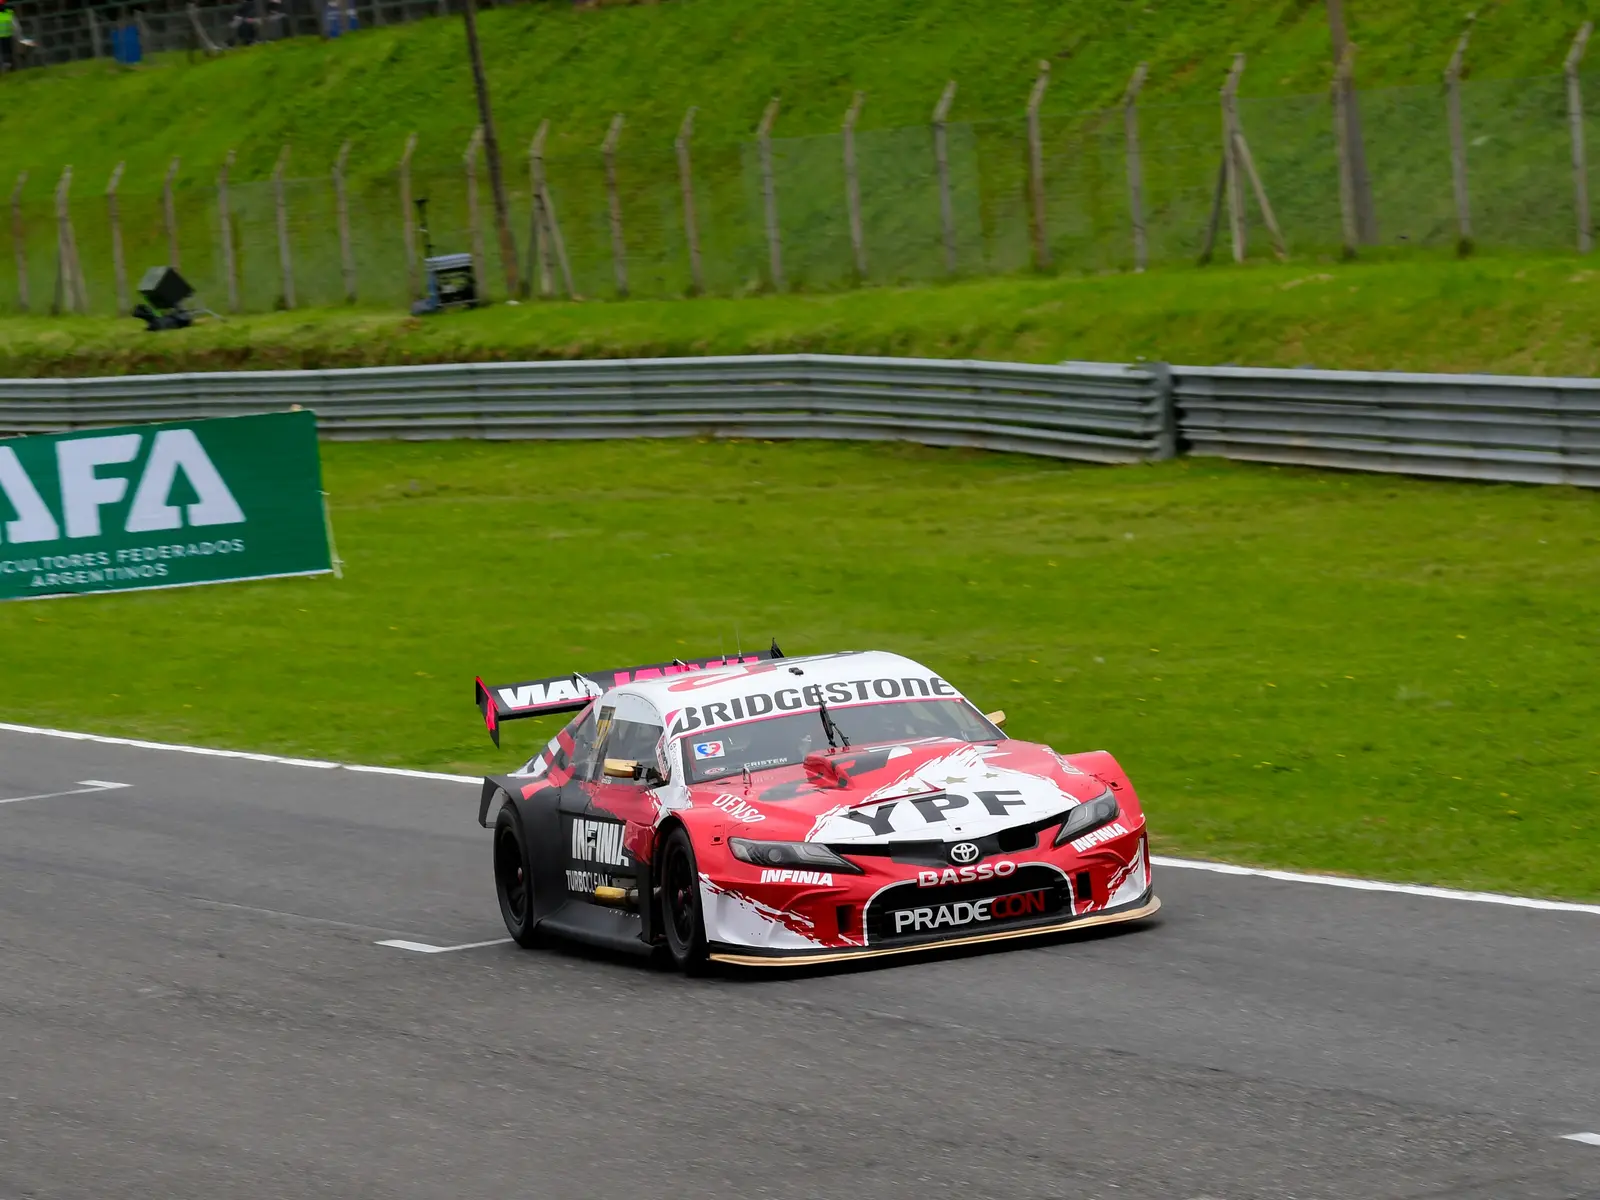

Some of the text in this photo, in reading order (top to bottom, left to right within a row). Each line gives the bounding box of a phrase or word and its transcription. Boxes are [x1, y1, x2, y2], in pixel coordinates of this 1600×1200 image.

[116, 538, 246, 563] FEDERADOS
[667, 677, 956, 737] BRIDGESTONE
[711, 792, 766, 823] DENSO
[837, 789, 1027, 836] YPF
[572, 818, 630, 867] INFINIA
[1070, 822, 1129, 853] INFINIA
[760, 869, 834, 887] INFINIA
[917, 860, 1016, 887] BASSO
[894, 889, 1046, 934] PRADECON
